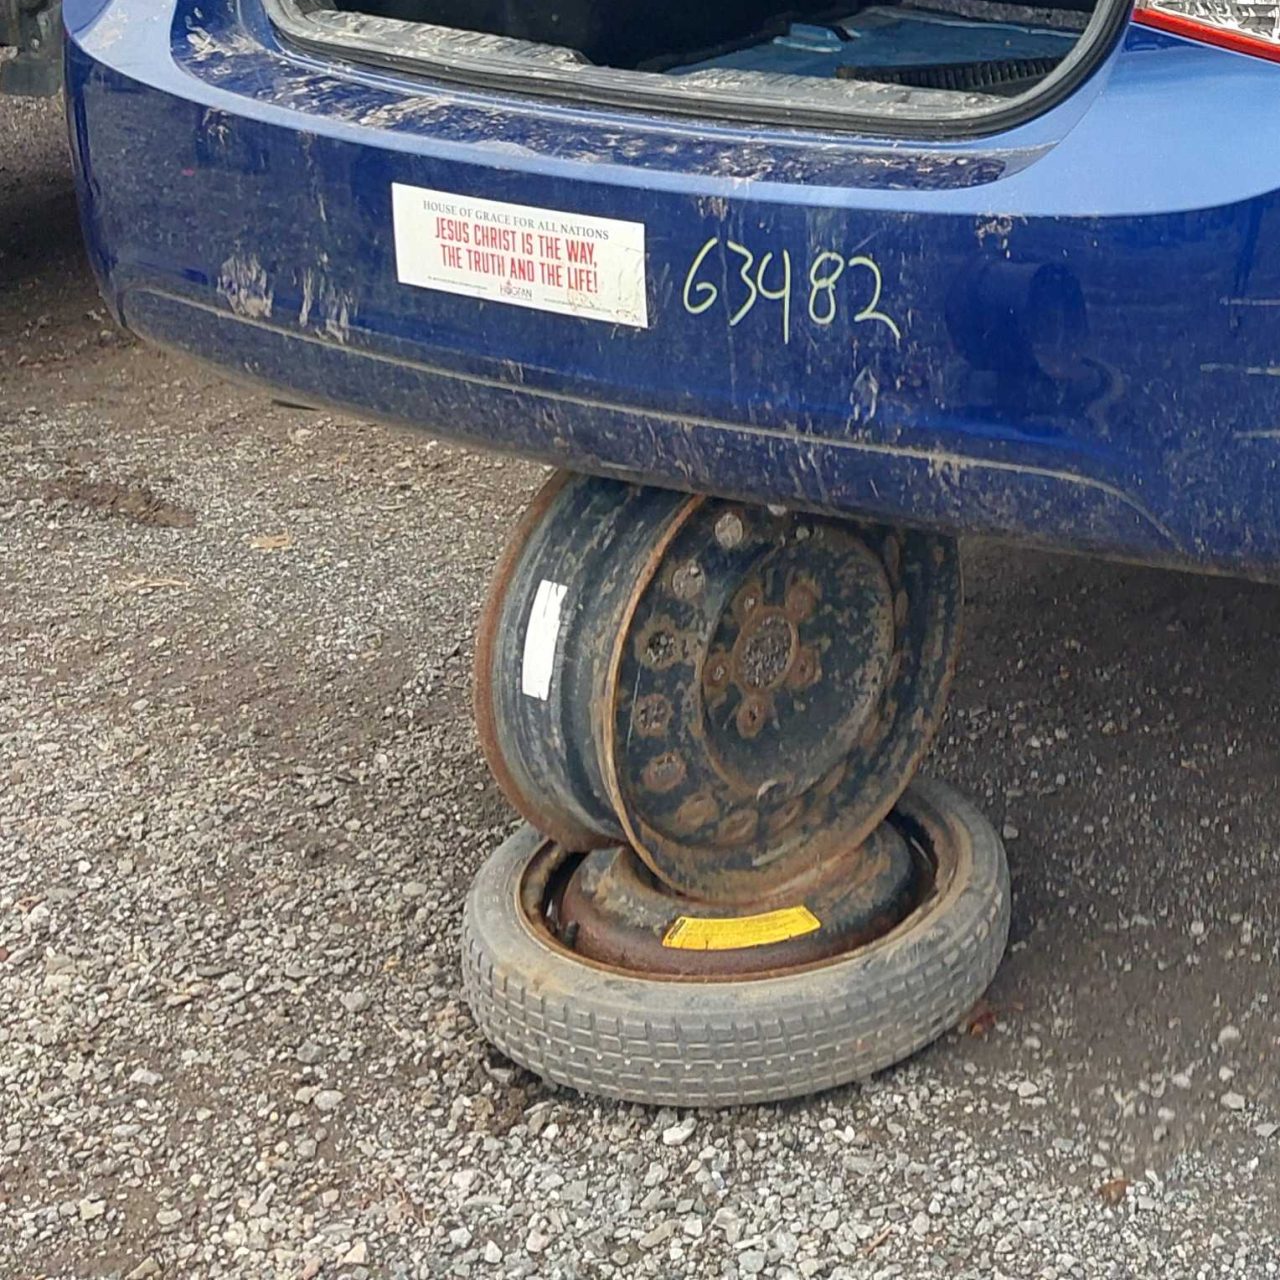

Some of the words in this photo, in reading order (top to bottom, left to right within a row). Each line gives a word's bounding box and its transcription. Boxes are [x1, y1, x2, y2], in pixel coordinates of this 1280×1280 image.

[423, 200, 457, 215] HOUSE
[459, 207, 473, 218] OF
[475, 210, 511, 225] GRACE
[513, 216, 535, 229] FOR
[538, 221, 558, 233] ALL
[560, 224, 609, 240] NATIONS
[435, 217, 470, 244] JESUS
[474, 224, 517, 253] CHRIST
[521, 231, 534, 255] IS
[537, 234, 562, 260] THE
[565, 238, 597, 268] WAY,
[440, 244, 463, 269] THE
[466, 249, 505, 277] TRUTH
[510, 257, 535, 282] AND
[539, 262, 563, 288] THE
[567, 266, 598, 294] LIFE!
[684, 238, 901, 343] 63482
